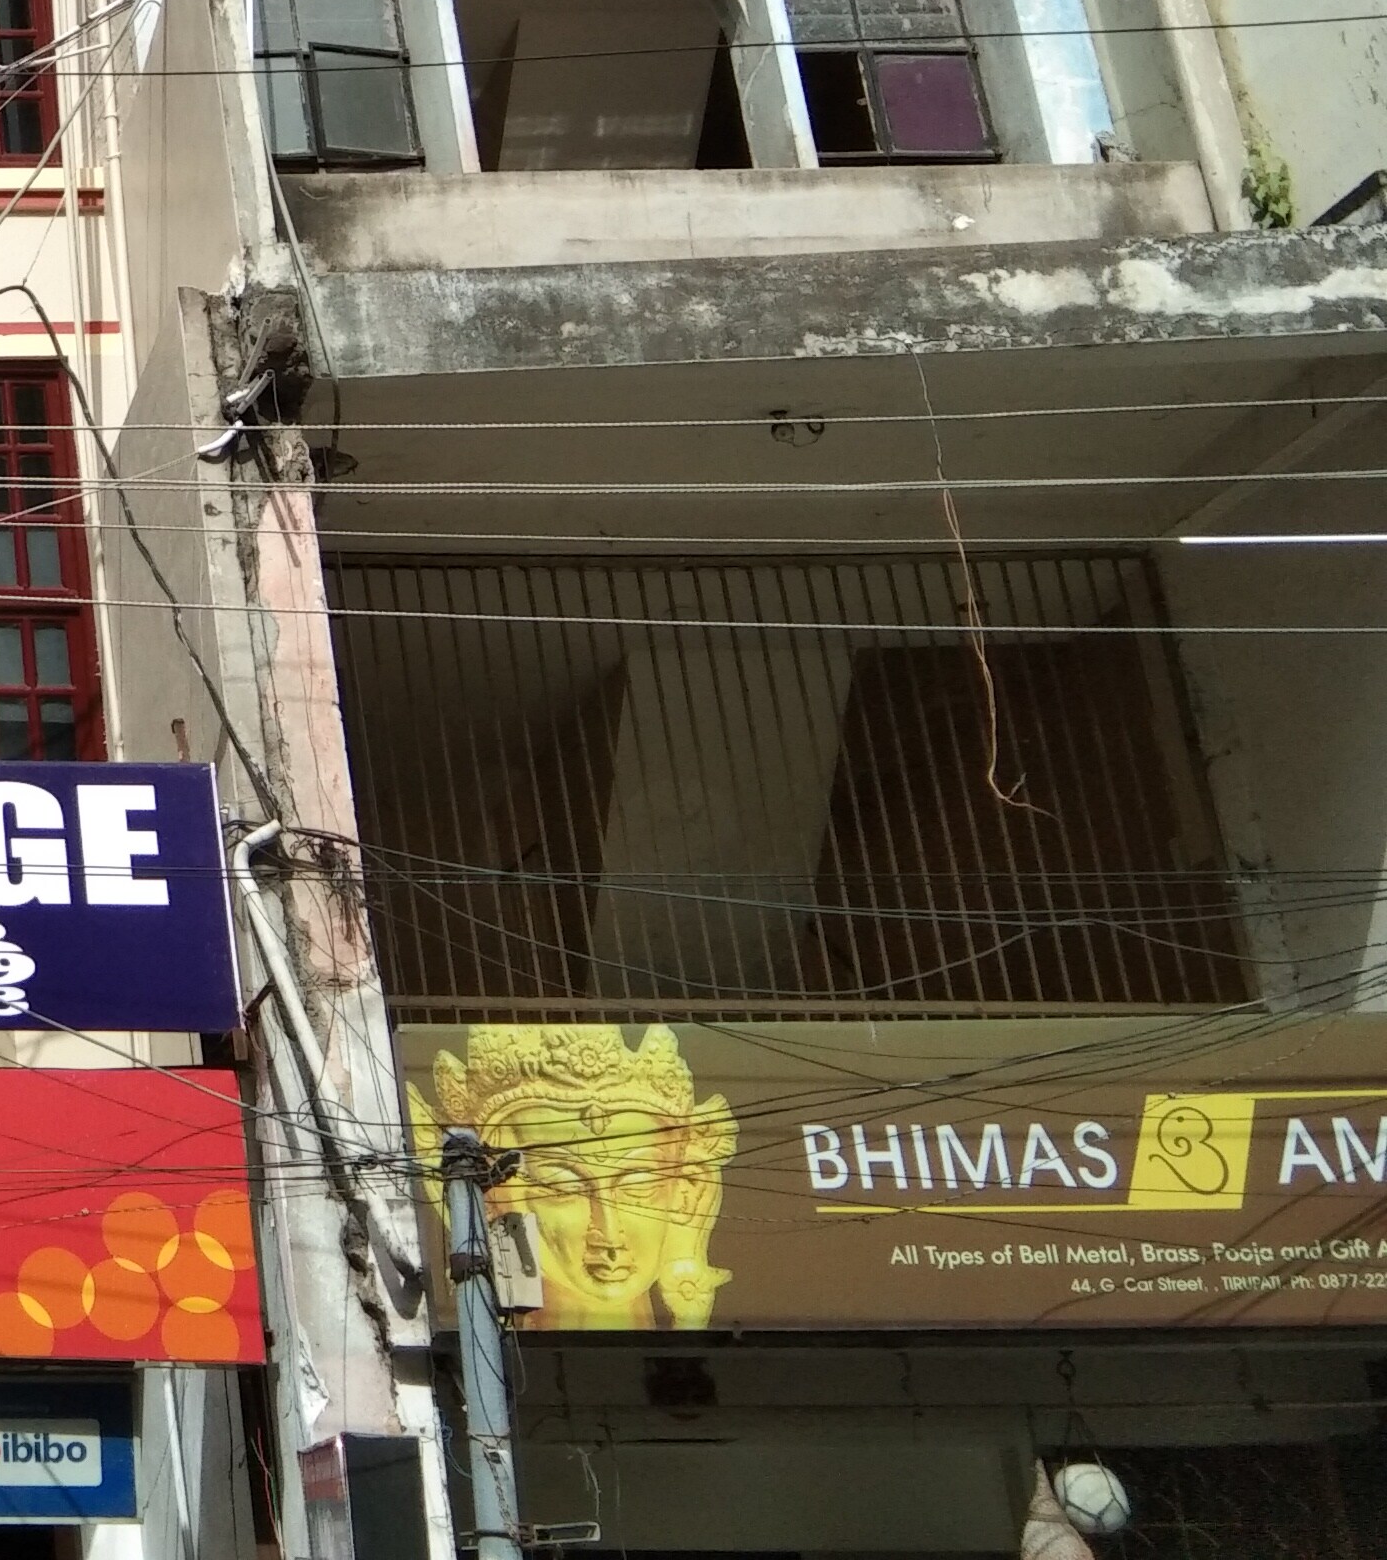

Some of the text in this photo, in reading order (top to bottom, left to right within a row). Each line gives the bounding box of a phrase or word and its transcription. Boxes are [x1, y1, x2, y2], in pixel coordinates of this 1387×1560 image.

[802, 1121, 1118, 1190] BHIMAS
[890, 1244, 919, 1265] All
[924, 1245, 985, 1269] Types
[990, 1244, 1013, 1265] of
[1019, 1243, 1060, 1264] Bell
[1066, 1242, 1135, 1266] Metal,
[1280, 1240, 1323, 1261] and
[1329, 1239, 1371, 1259] Gift
[1070, 1278, 1096, 1293] 44,
[1123, 1277, 1153, 1292] Car
[1318, 1272, 1387, 1289] 0877-22
